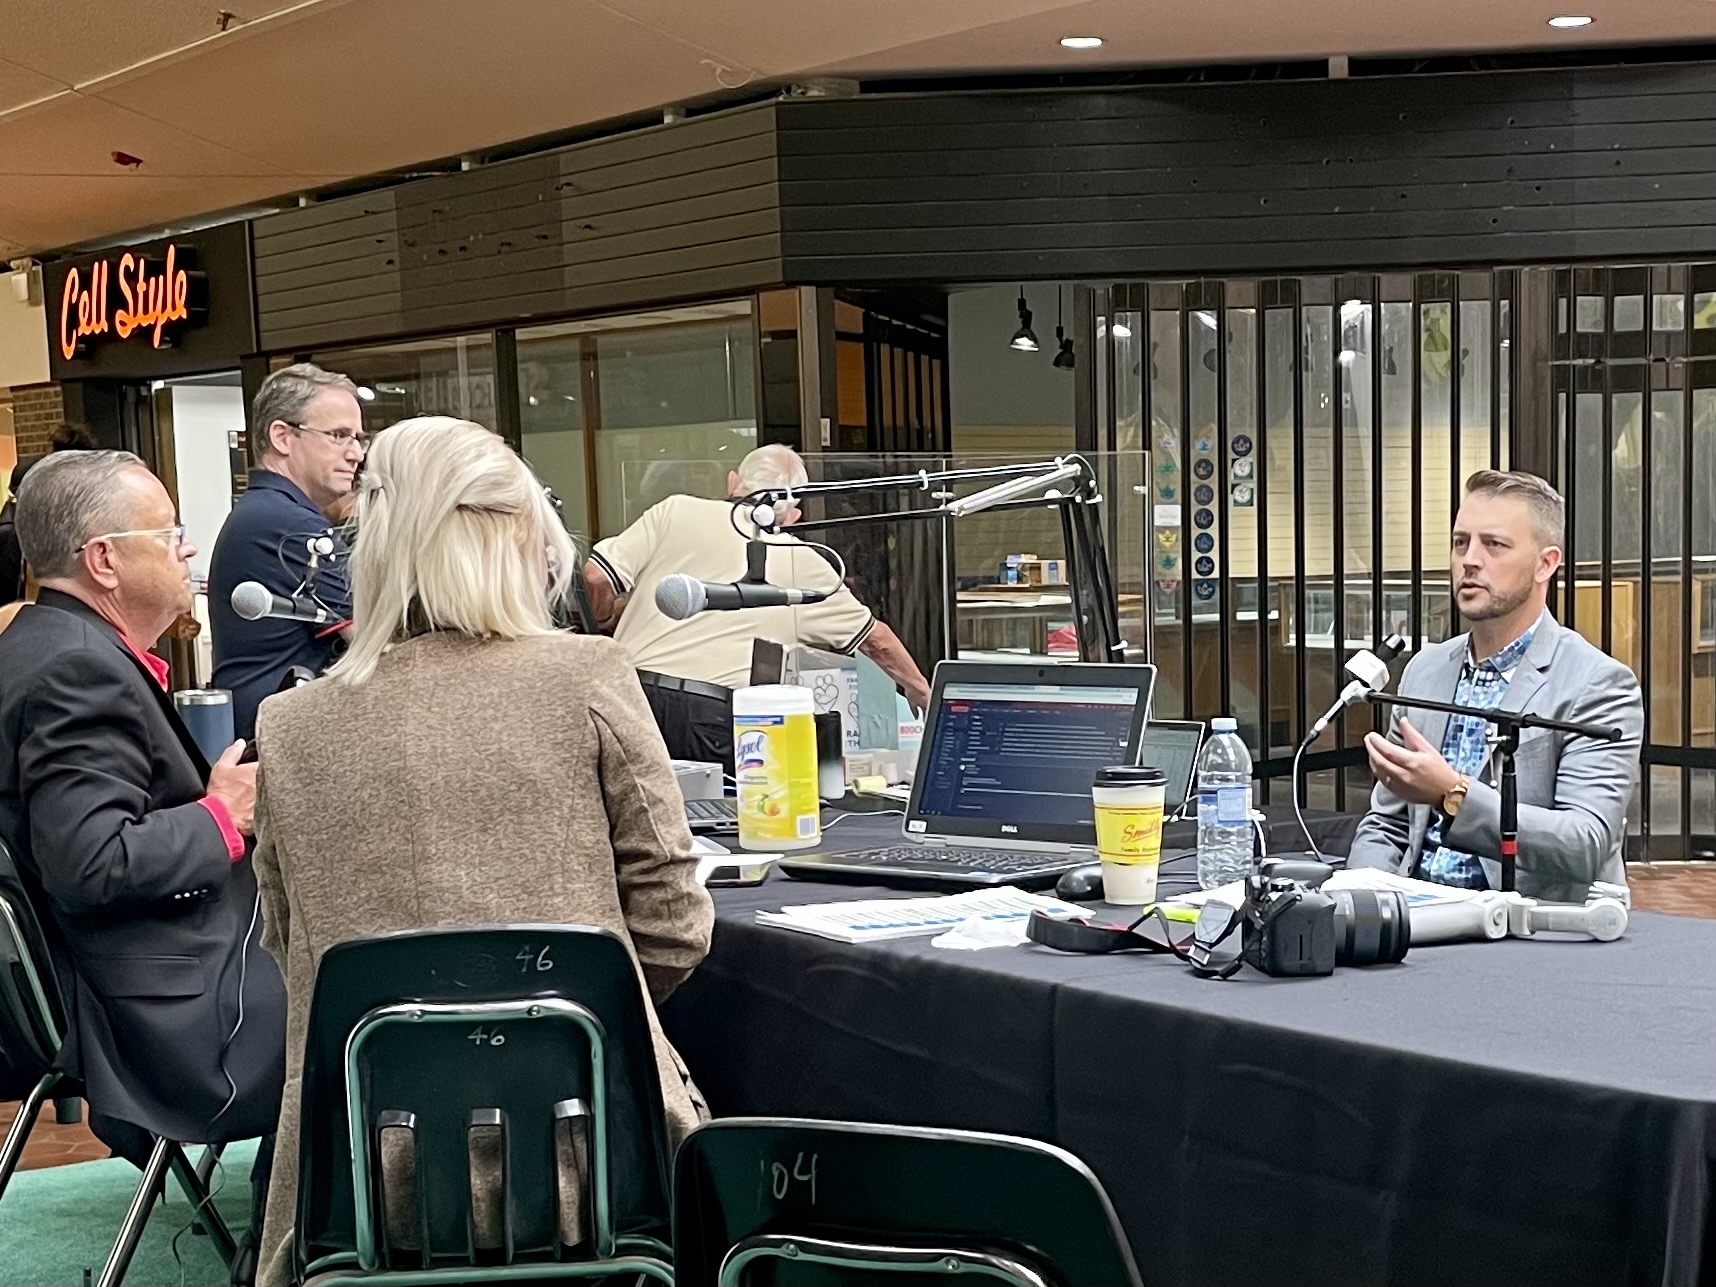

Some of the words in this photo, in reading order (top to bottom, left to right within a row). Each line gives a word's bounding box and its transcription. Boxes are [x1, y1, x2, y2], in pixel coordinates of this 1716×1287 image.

[61, 259, 108, 360] Cell
[115, 244, 188, 349] Style
[1001, 825, 1018, 833] DELL
[516, 945, 554, 973] 46
[467, 1025, 505, 1046] 46
[757, 1152, 818, 1209] 104
